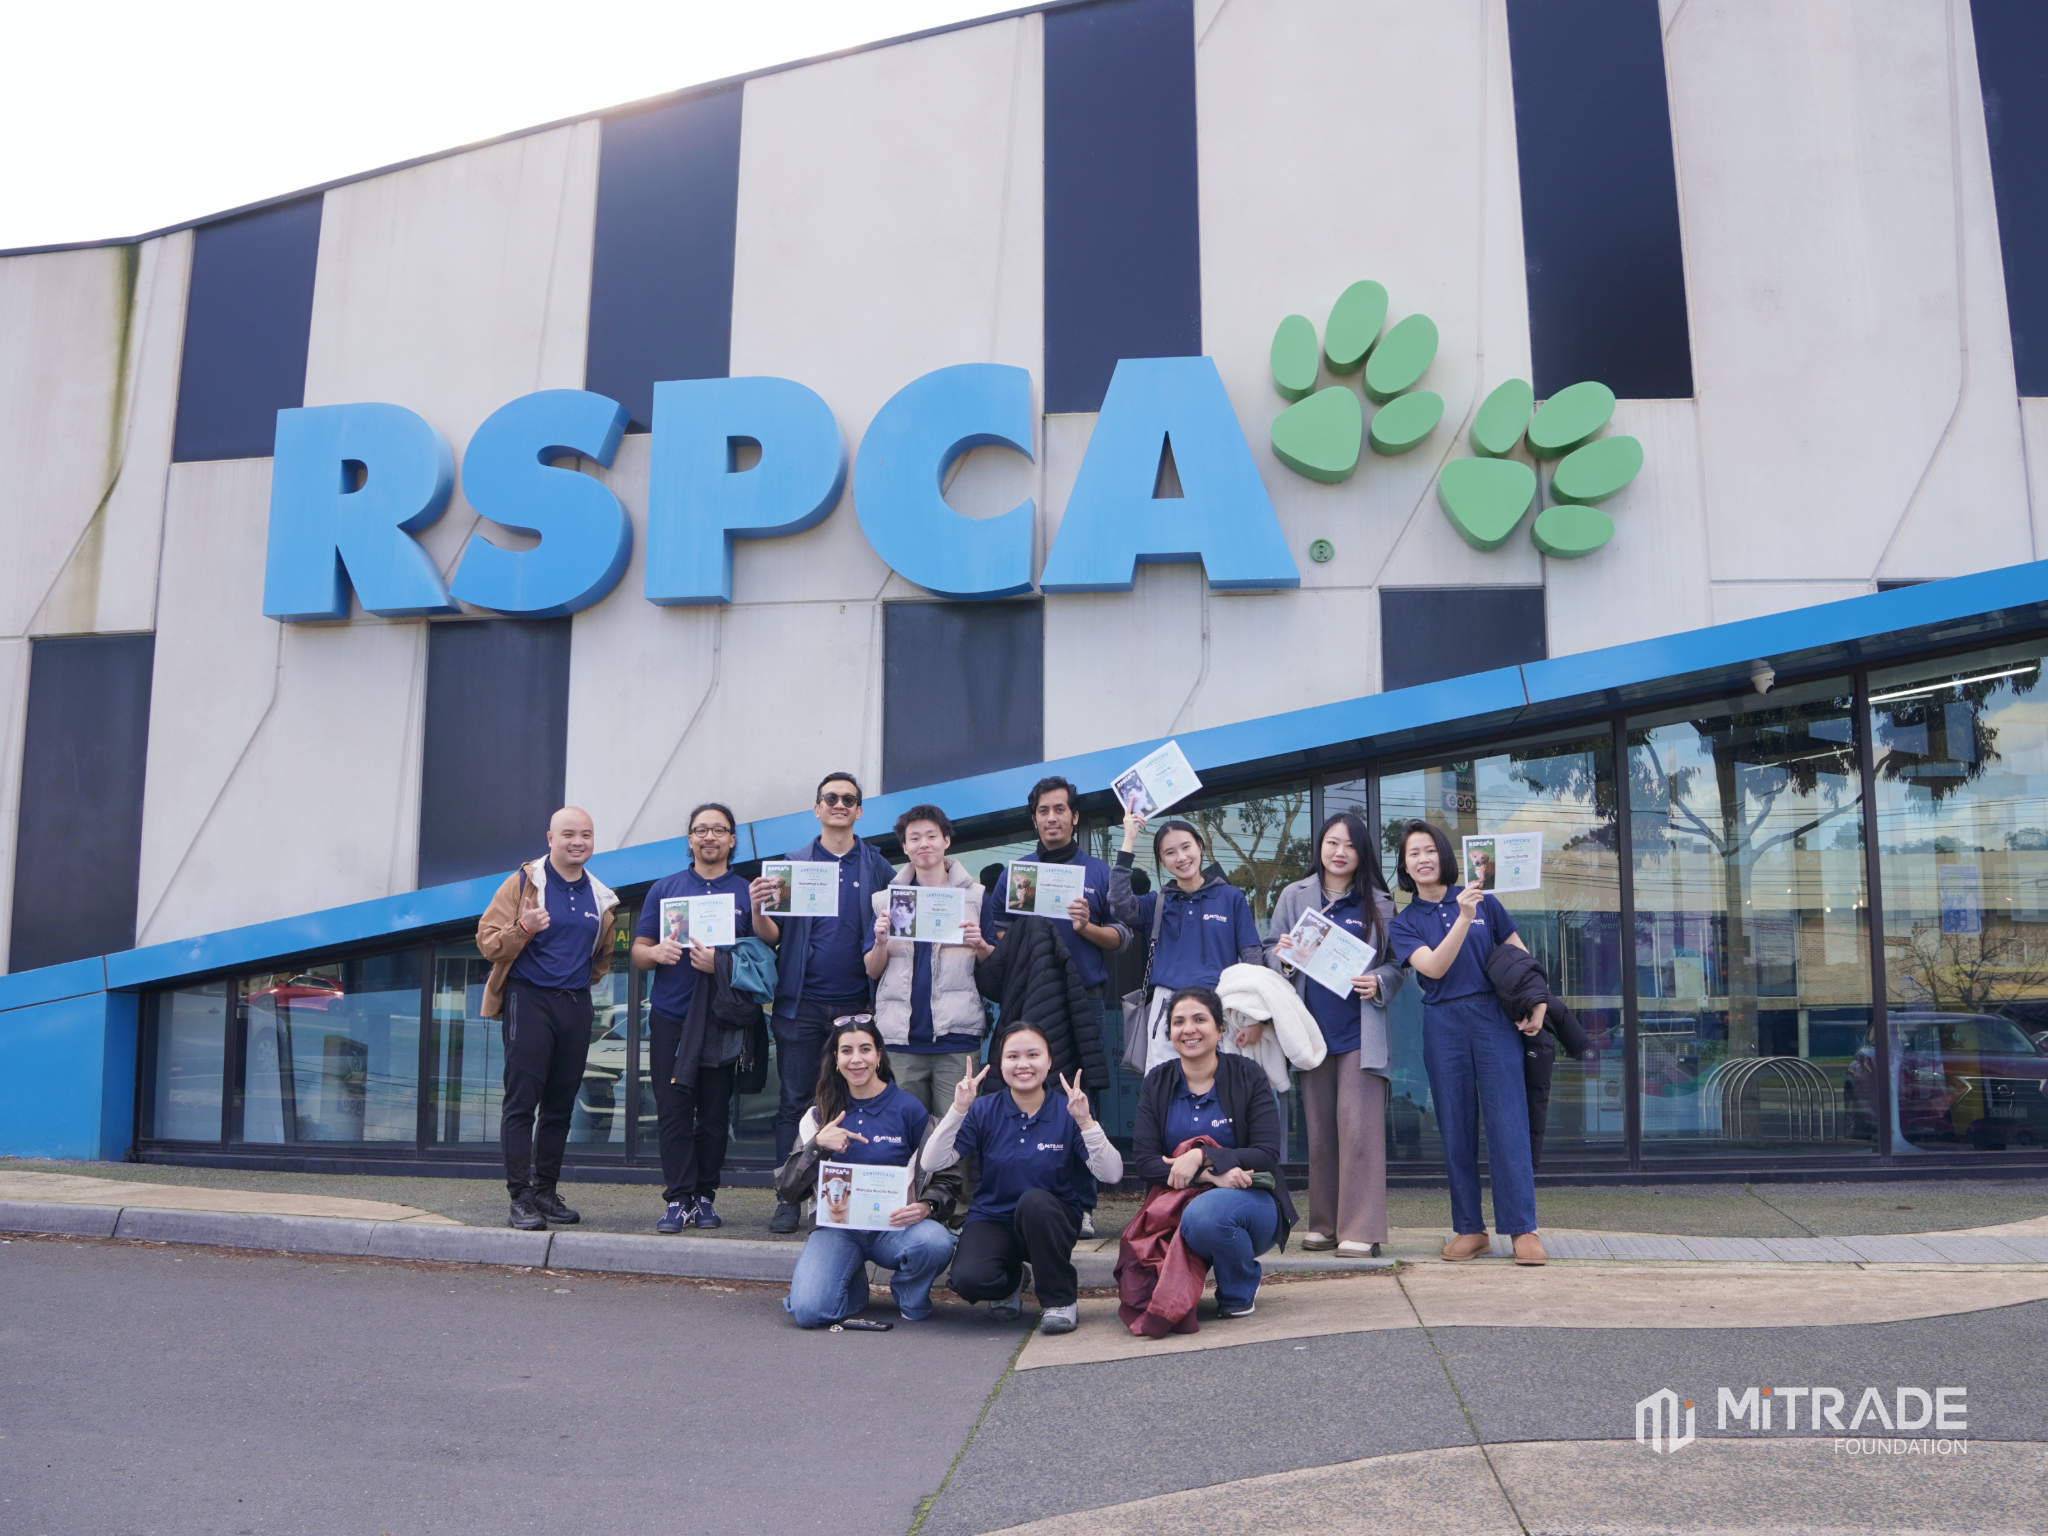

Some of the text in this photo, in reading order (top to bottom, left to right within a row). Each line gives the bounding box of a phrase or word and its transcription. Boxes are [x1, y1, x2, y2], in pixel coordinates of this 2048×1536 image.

[263, 355, 1300, 620] RSPCA
[1644, 897, 1686, 907] together
[1336, 936, 1361, 954] CERTIFICATE
[863, 1171, 895, 1179] CERTIFICATE
